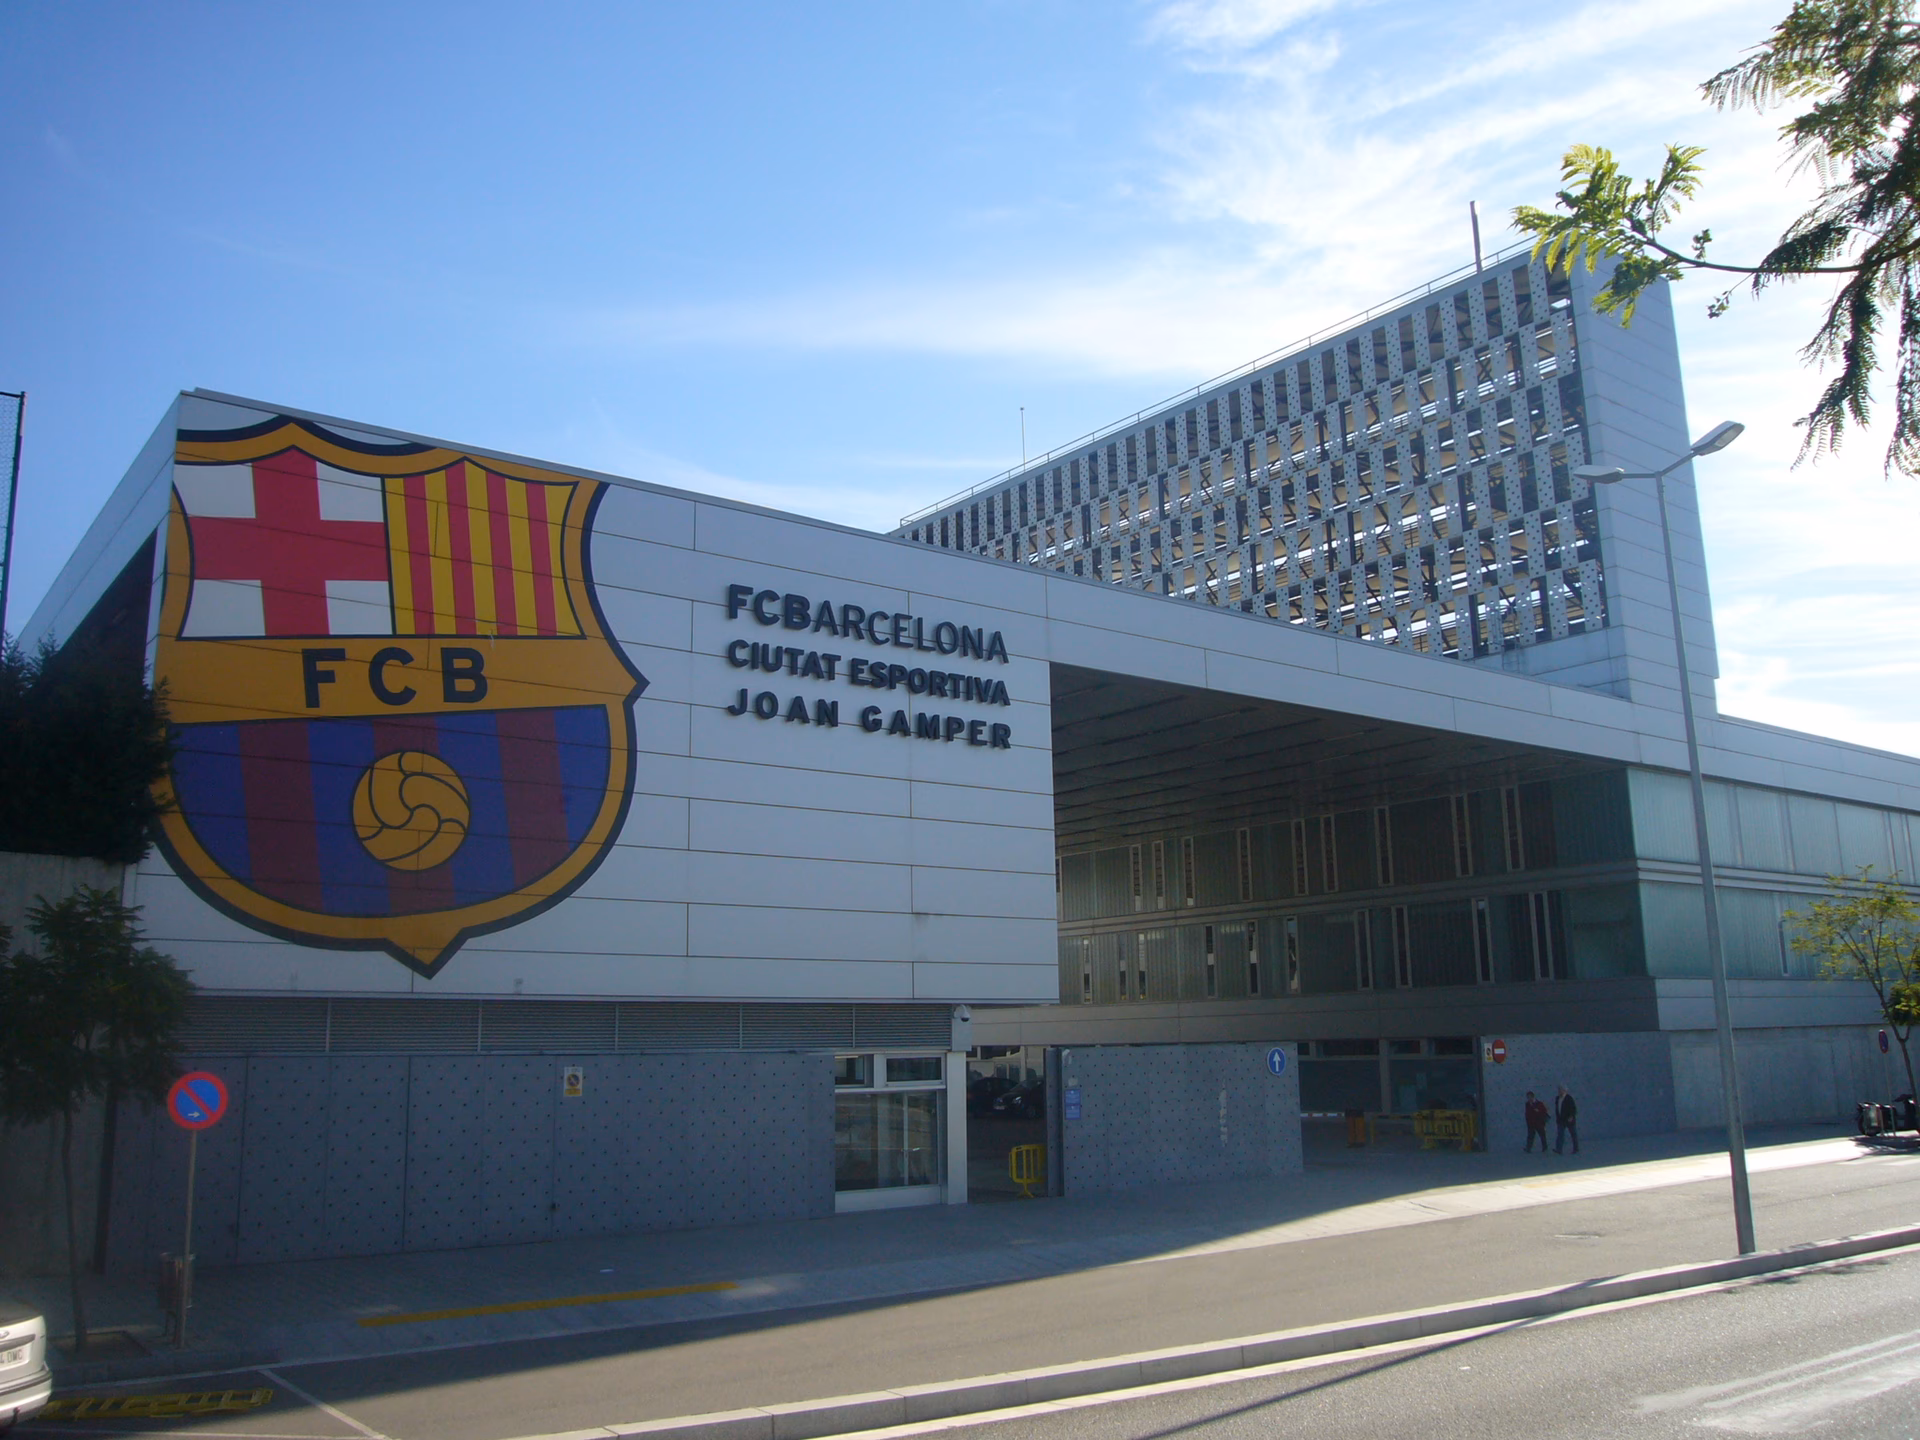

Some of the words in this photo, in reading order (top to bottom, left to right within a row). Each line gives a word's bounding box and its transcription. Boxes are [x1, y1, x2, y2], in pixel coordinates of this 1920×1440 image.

[728, 584, 1010, 664] FCBARCELONA
[301, 646, 488, 708] FCB
[728, 639, 842, 681] CIUTAT
[850, 657, 1011, 706] ESPORTIVA
[727, 688, 839, 727] JOAN
[861, 705, 1012, 749] GAMPER
